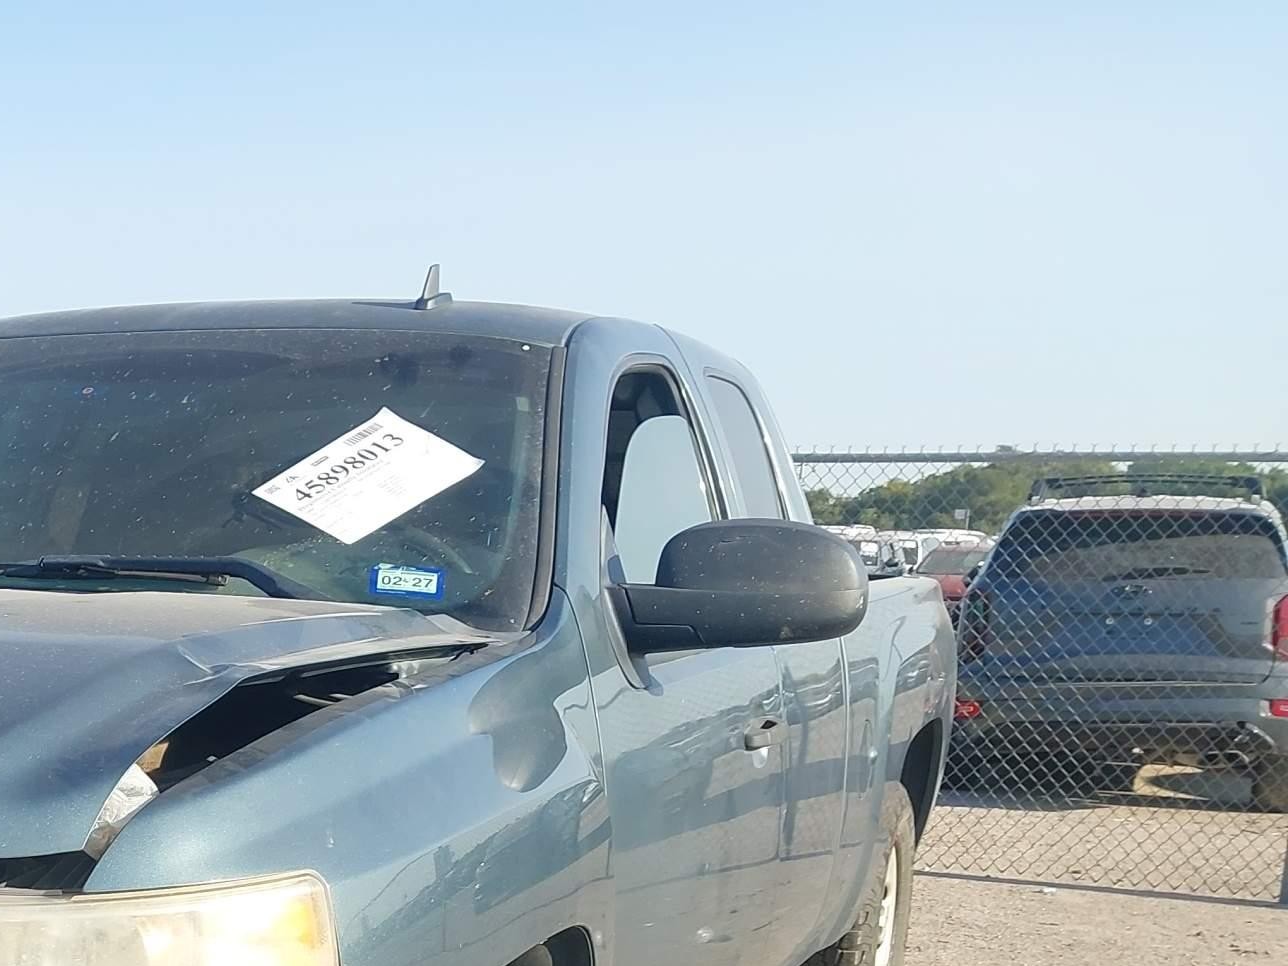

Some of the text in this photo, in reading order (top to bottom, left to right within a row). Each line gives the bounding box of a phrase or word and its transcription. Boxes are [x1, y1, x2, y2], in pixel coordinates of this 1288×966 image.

[295, 433, 404, 502] 45898013
[381, 575, 434, 588] 02 27
